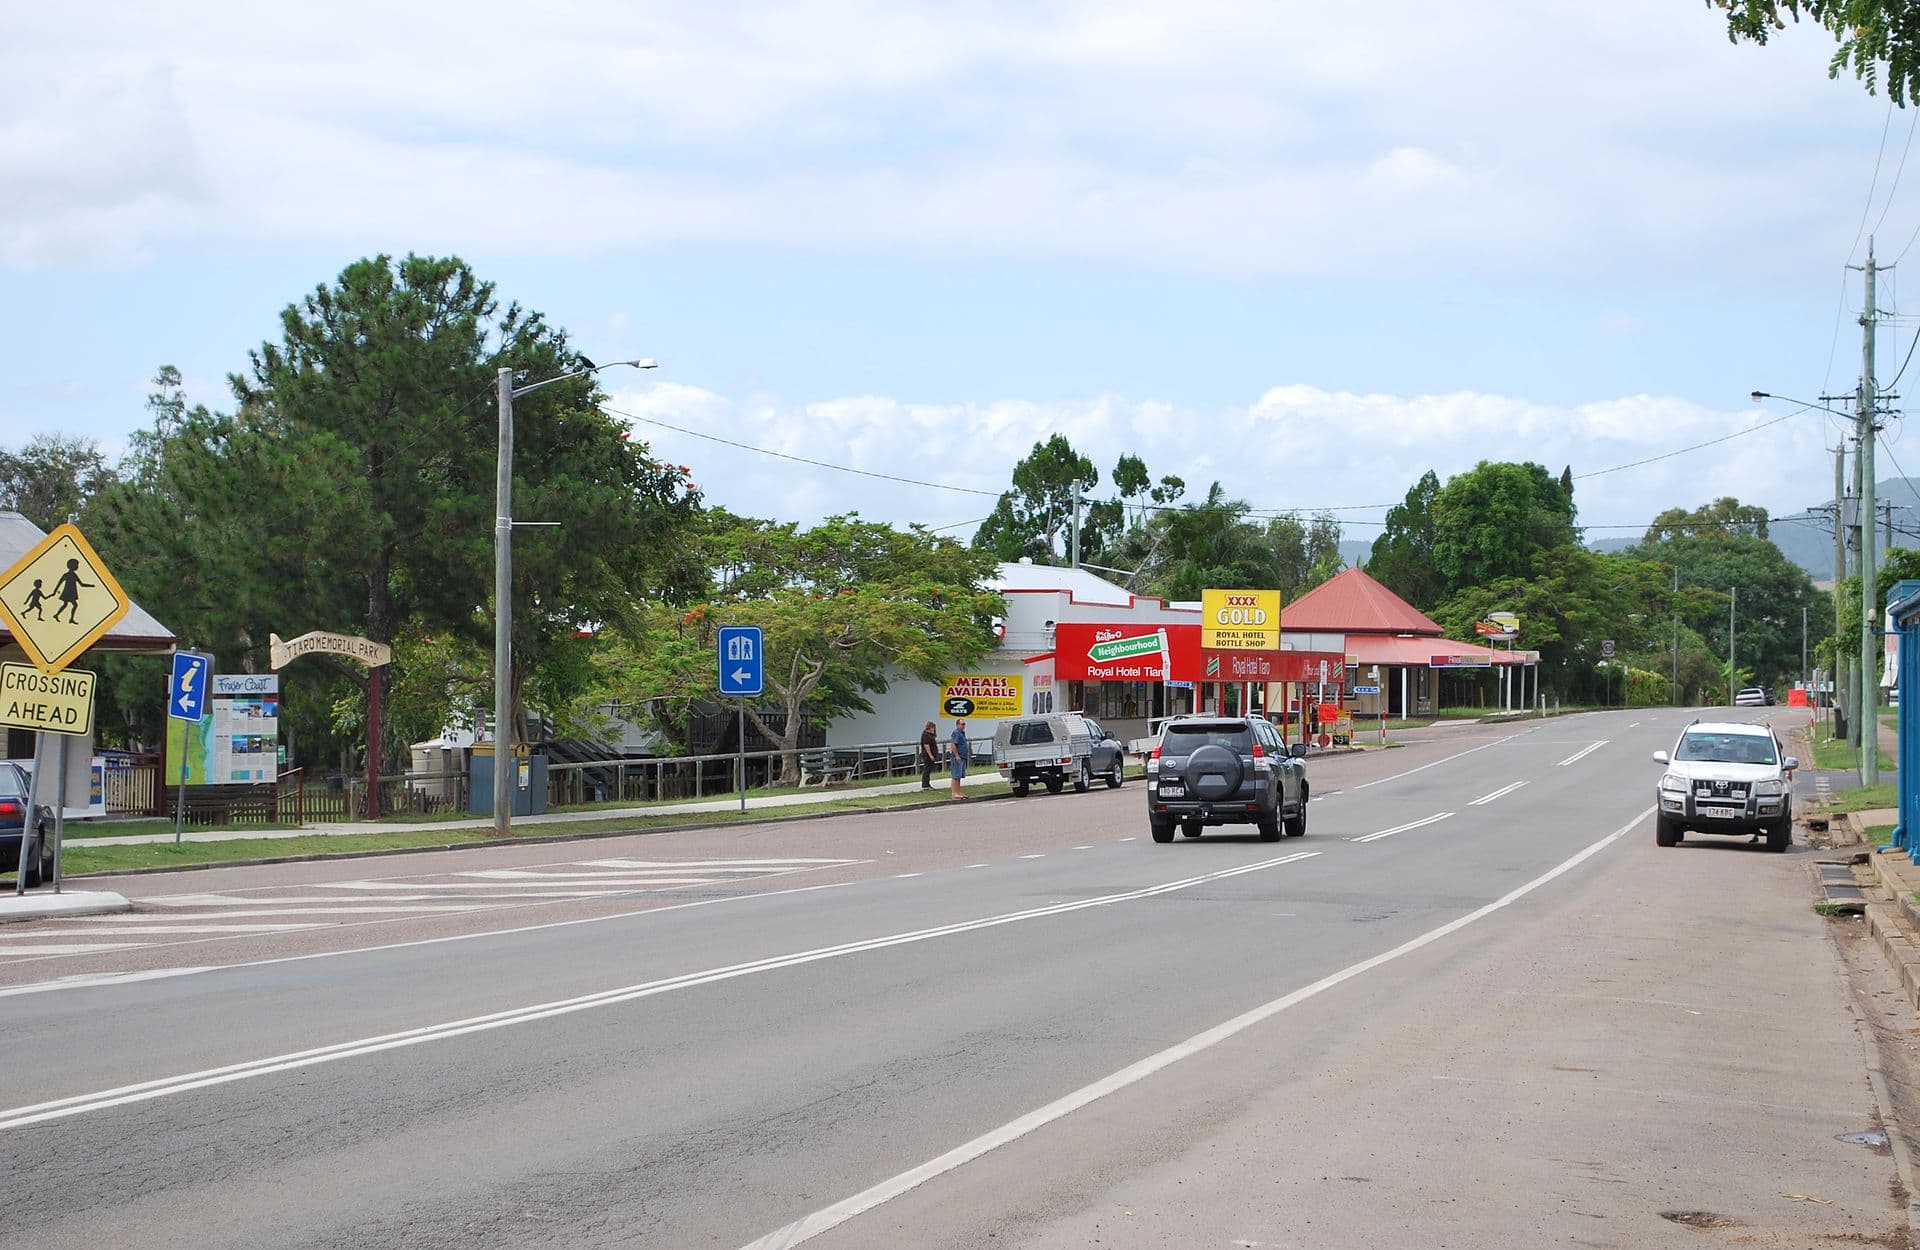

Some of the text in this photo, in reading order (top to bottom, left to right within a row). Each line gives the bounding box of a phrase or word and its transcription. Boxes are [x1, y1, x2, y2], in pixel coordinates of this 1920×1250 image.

[1228, 597, 1256, 606] XXXX
[1217, 608, 1267, 625] GOLD
[287, 637, 379, 659] TIARO MEMORIAL PARK
[1098, 638, 1158, 656] Neighbourhood
[1087, 666, 1164, 678] Royal Hotel Tiar
[1232, 656, 1246, 678] Royal
[1246, 656, 1258, 675] Hotel
[1258, 657, 1271, 676] Tiaro
[6, 672, 88, 697] CROSSING
[217, 677, 272, 691] Fraser Coast
[956, 677, 1008, 687] MEALS
[946, 687, 1017, 697] AVAILABLE
[950, 700, 968, 709] 7
[7, 701, 77, 725] AHEAD
